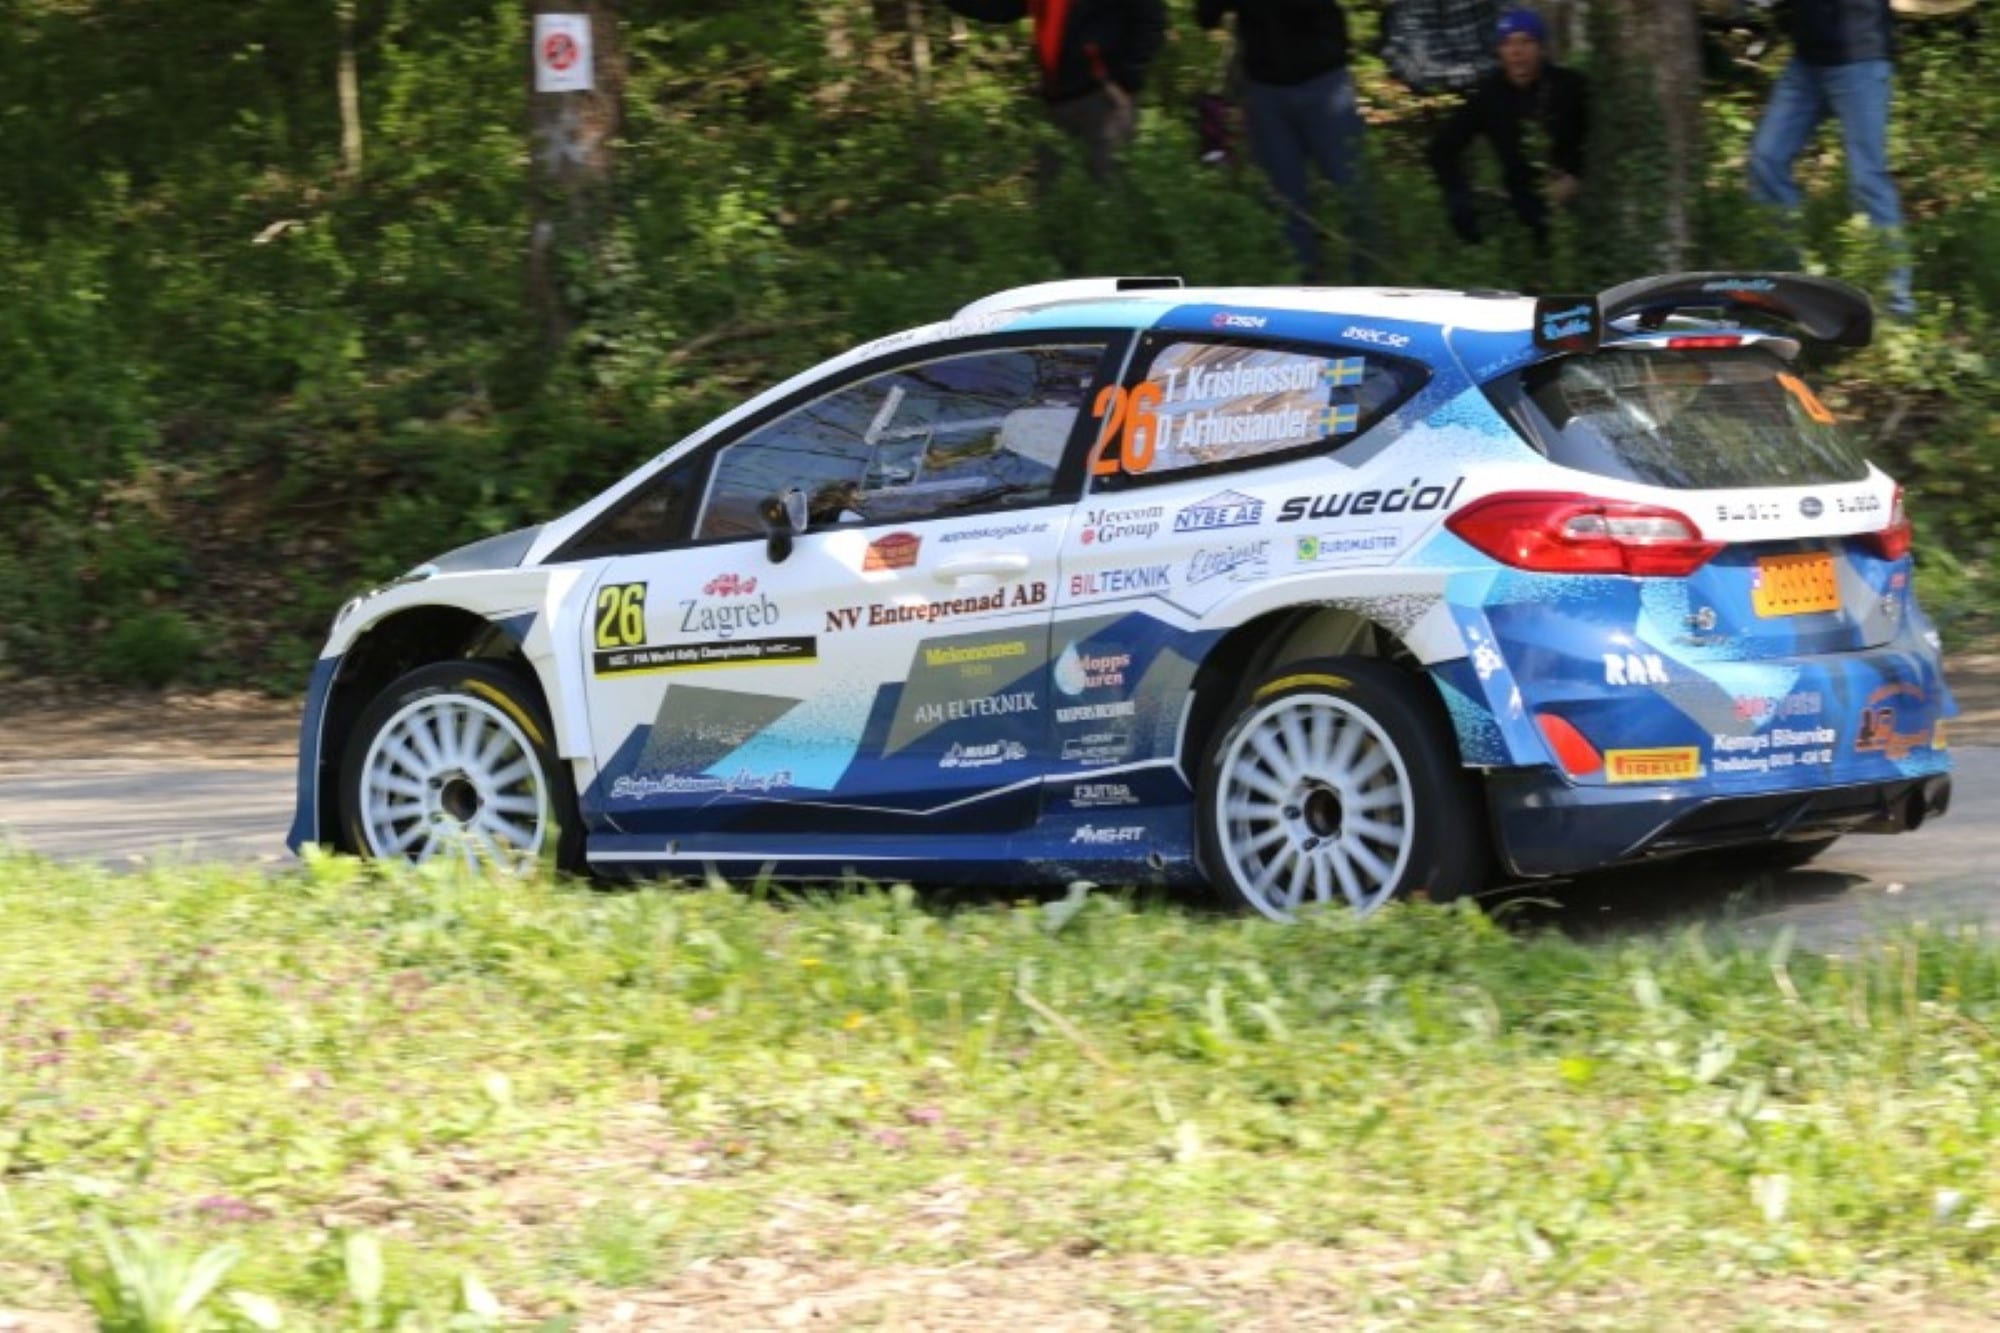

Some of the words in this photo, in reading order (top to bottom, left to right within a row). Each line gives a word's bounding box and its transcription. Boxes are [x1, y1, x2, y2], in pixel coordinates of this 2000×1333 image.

[1165, 367, 1181, 402] T
[1187, 362, 1320, 400] Kristensson
[1092, 381, 1162, 474] 26
[1155, 411, 1172, 450] D
[1099, 522, 1160, 543] Group
[1175, 508, 1229, 528] NYBE
[1235, 505, 1263, 521] AB
[1320, 536, 1398, 554] EUROMASTER
[1071, 564, 1171, 596] BILTEKNIK
[598, 584, 645, 647] 26
[680, 593, 780, 637] Zagreb
[825, 606, 862, 632] NV
[868, 587, 1005, 625] Entreprenad
[1012, 582, 1048, 607] AB
[914, 702, 944, 723] AM
[948, 692, 1038, 720] ELTEKNIK
[1615, 752, 1691, 776] PIRELLI
